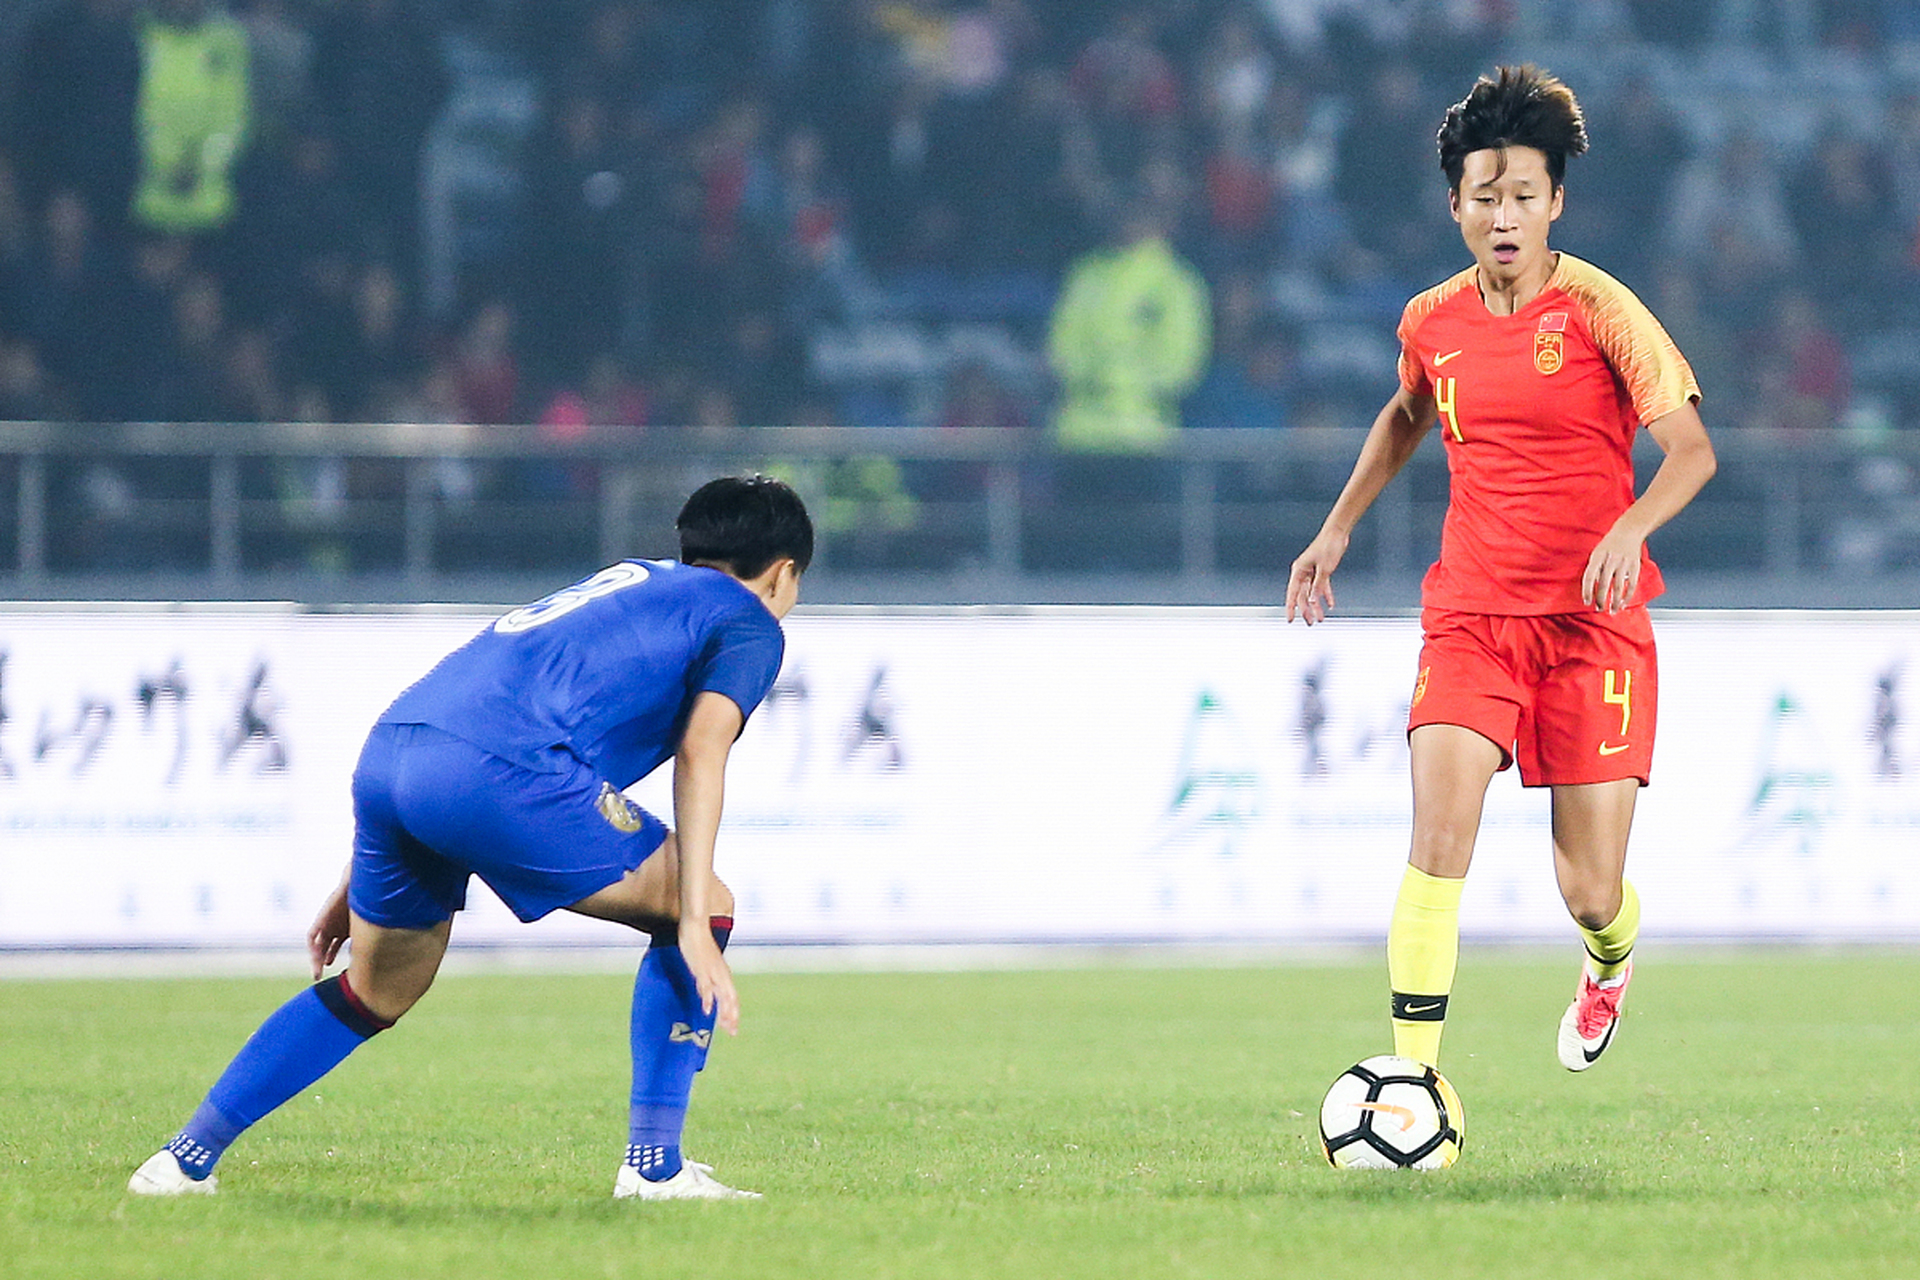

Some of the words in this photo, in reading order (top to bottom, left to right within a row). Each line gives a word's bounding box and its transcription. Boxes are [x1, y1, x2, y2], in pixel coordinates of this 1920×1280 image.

[1537, 335, 1560, 344] CFA
[1436, 377, 1464, 443] 4
[1603, 669, 1632, 737] 4
